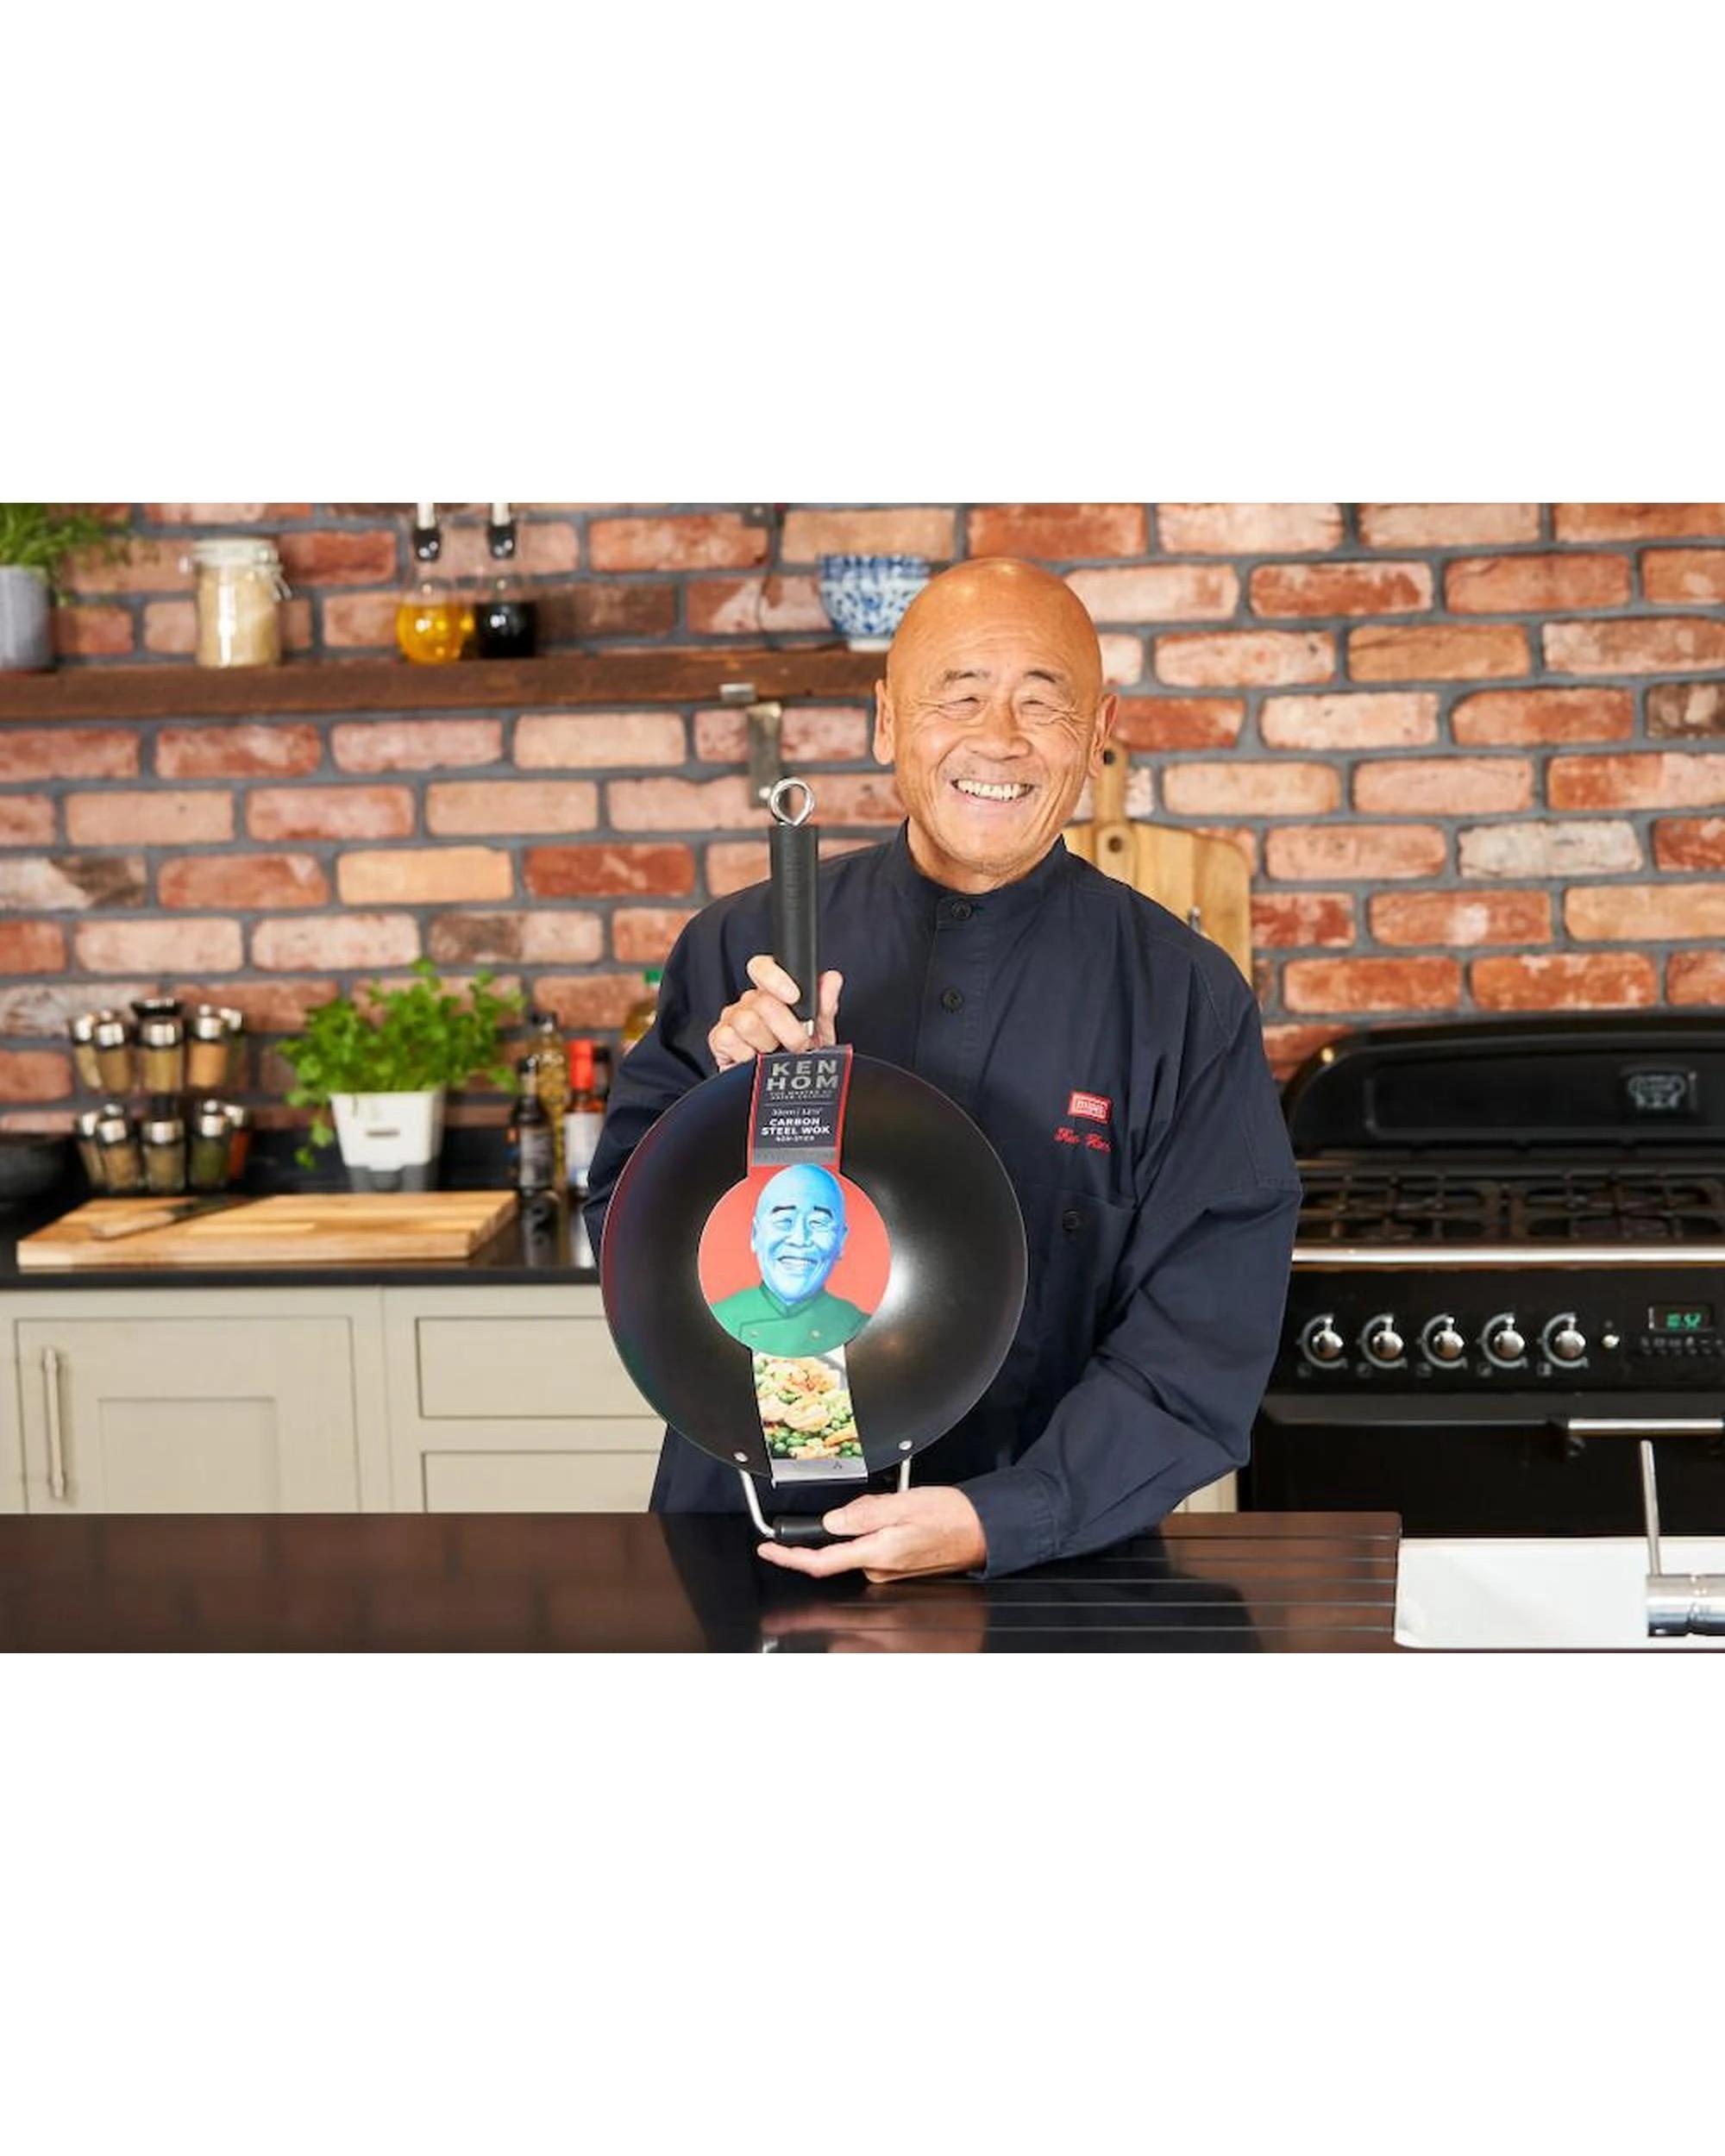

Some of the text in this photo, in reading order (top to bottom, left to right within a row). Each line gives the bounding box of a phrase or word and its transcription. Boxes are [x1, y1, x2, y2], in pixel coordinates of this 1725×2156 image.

[772, 1060, 837, 1076] KEN
[766, 1075, 839, 1091] HOM
[761, 1125, 831, 1136] STEEL WOK
